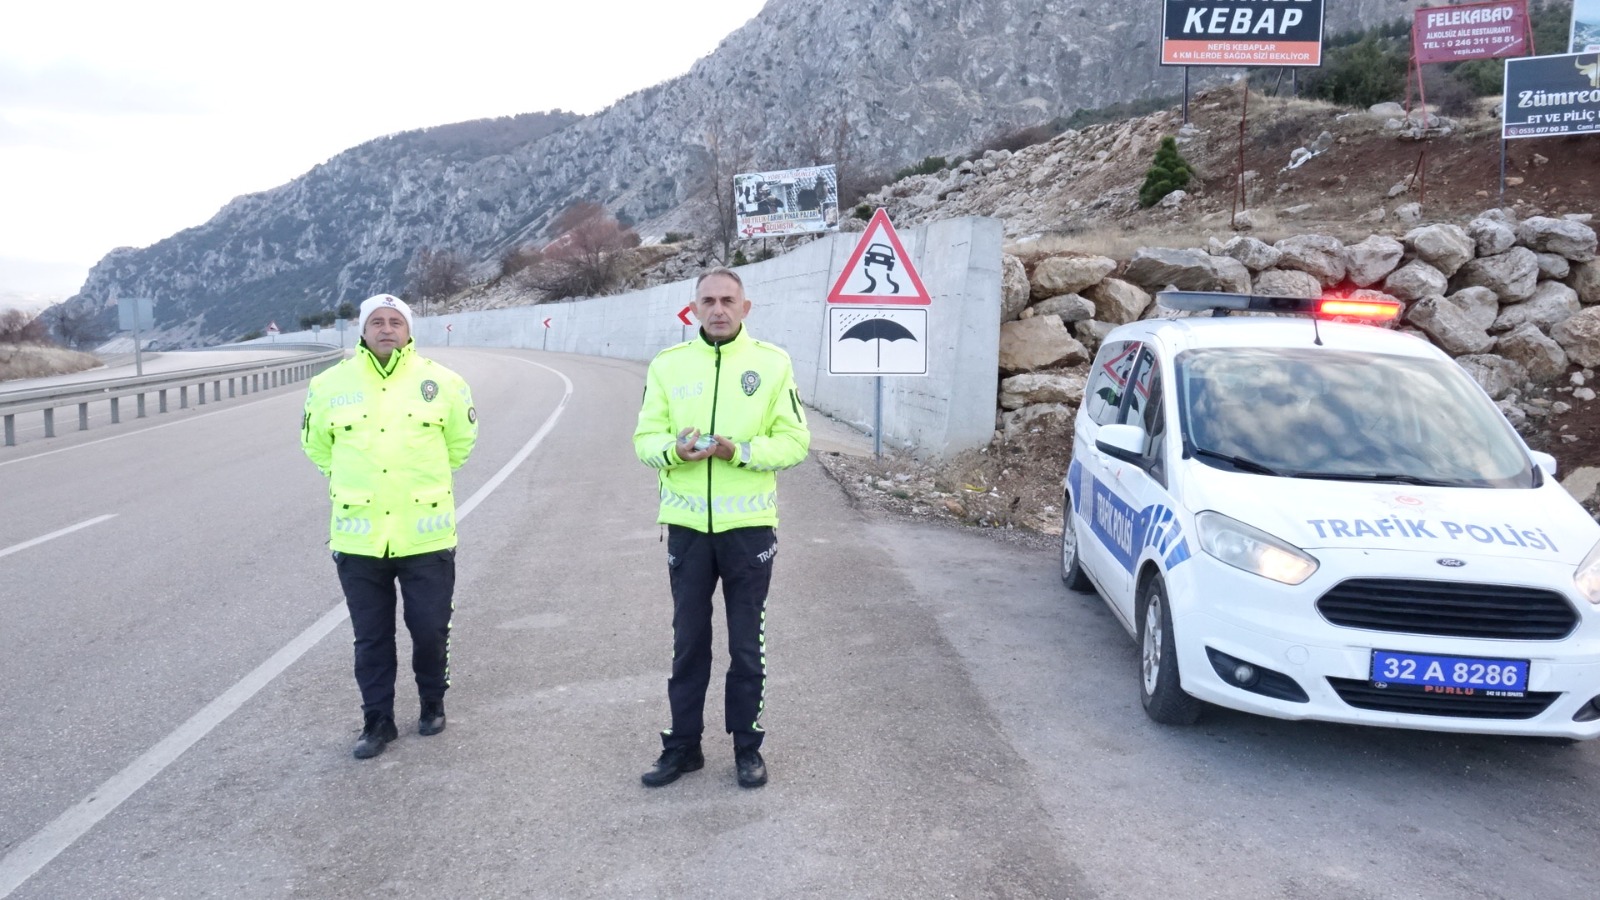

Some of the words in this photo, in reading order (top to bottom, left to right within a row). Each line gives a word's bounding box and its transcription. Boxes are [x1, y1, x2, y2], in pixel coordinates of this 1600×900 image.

[1183, 7, 1303, 35] KEBAP
[1427, 7, 1513, 28] FELEKABAD
[1426, 29, 1456, 39] ALKOLSÜZ
[1457, 28, 1471, 37] AİLE
[1472, 26, 1512, 36] RESTAURANTI
[1207, 43, 1231, 51] NEFİS
[1455, 39, 1471, 47] 246
[1473, 37, 1489, 45] 311
[1193, 51, 1222, 59] İLERDE
[1223, 51, 1252, 60] SAĞDA
[1253, 51, 1268, 60] SİZİ
[1270, 52, 1310, 60] BEKLİYOR
[1453, 48, 1485, 56] YEŞİLADA
[1527, 114, 1543, 124] ET
[1544, 113, 1561, 123] VE
[1563, 108, 1595, 121] PİLİÇ
[1576, 123, 1594, 131] Cami
[1306, 514, 1438, 539] TRAFİK
[1440, 519, 1559, 553] POLİSİ
[1383, 657, 1416, 680] 32
[1422, 661, 1445, 682] A
[1452, 662, 1517, 686] 8286
[1424, 685, 1475, 696] PURLU
